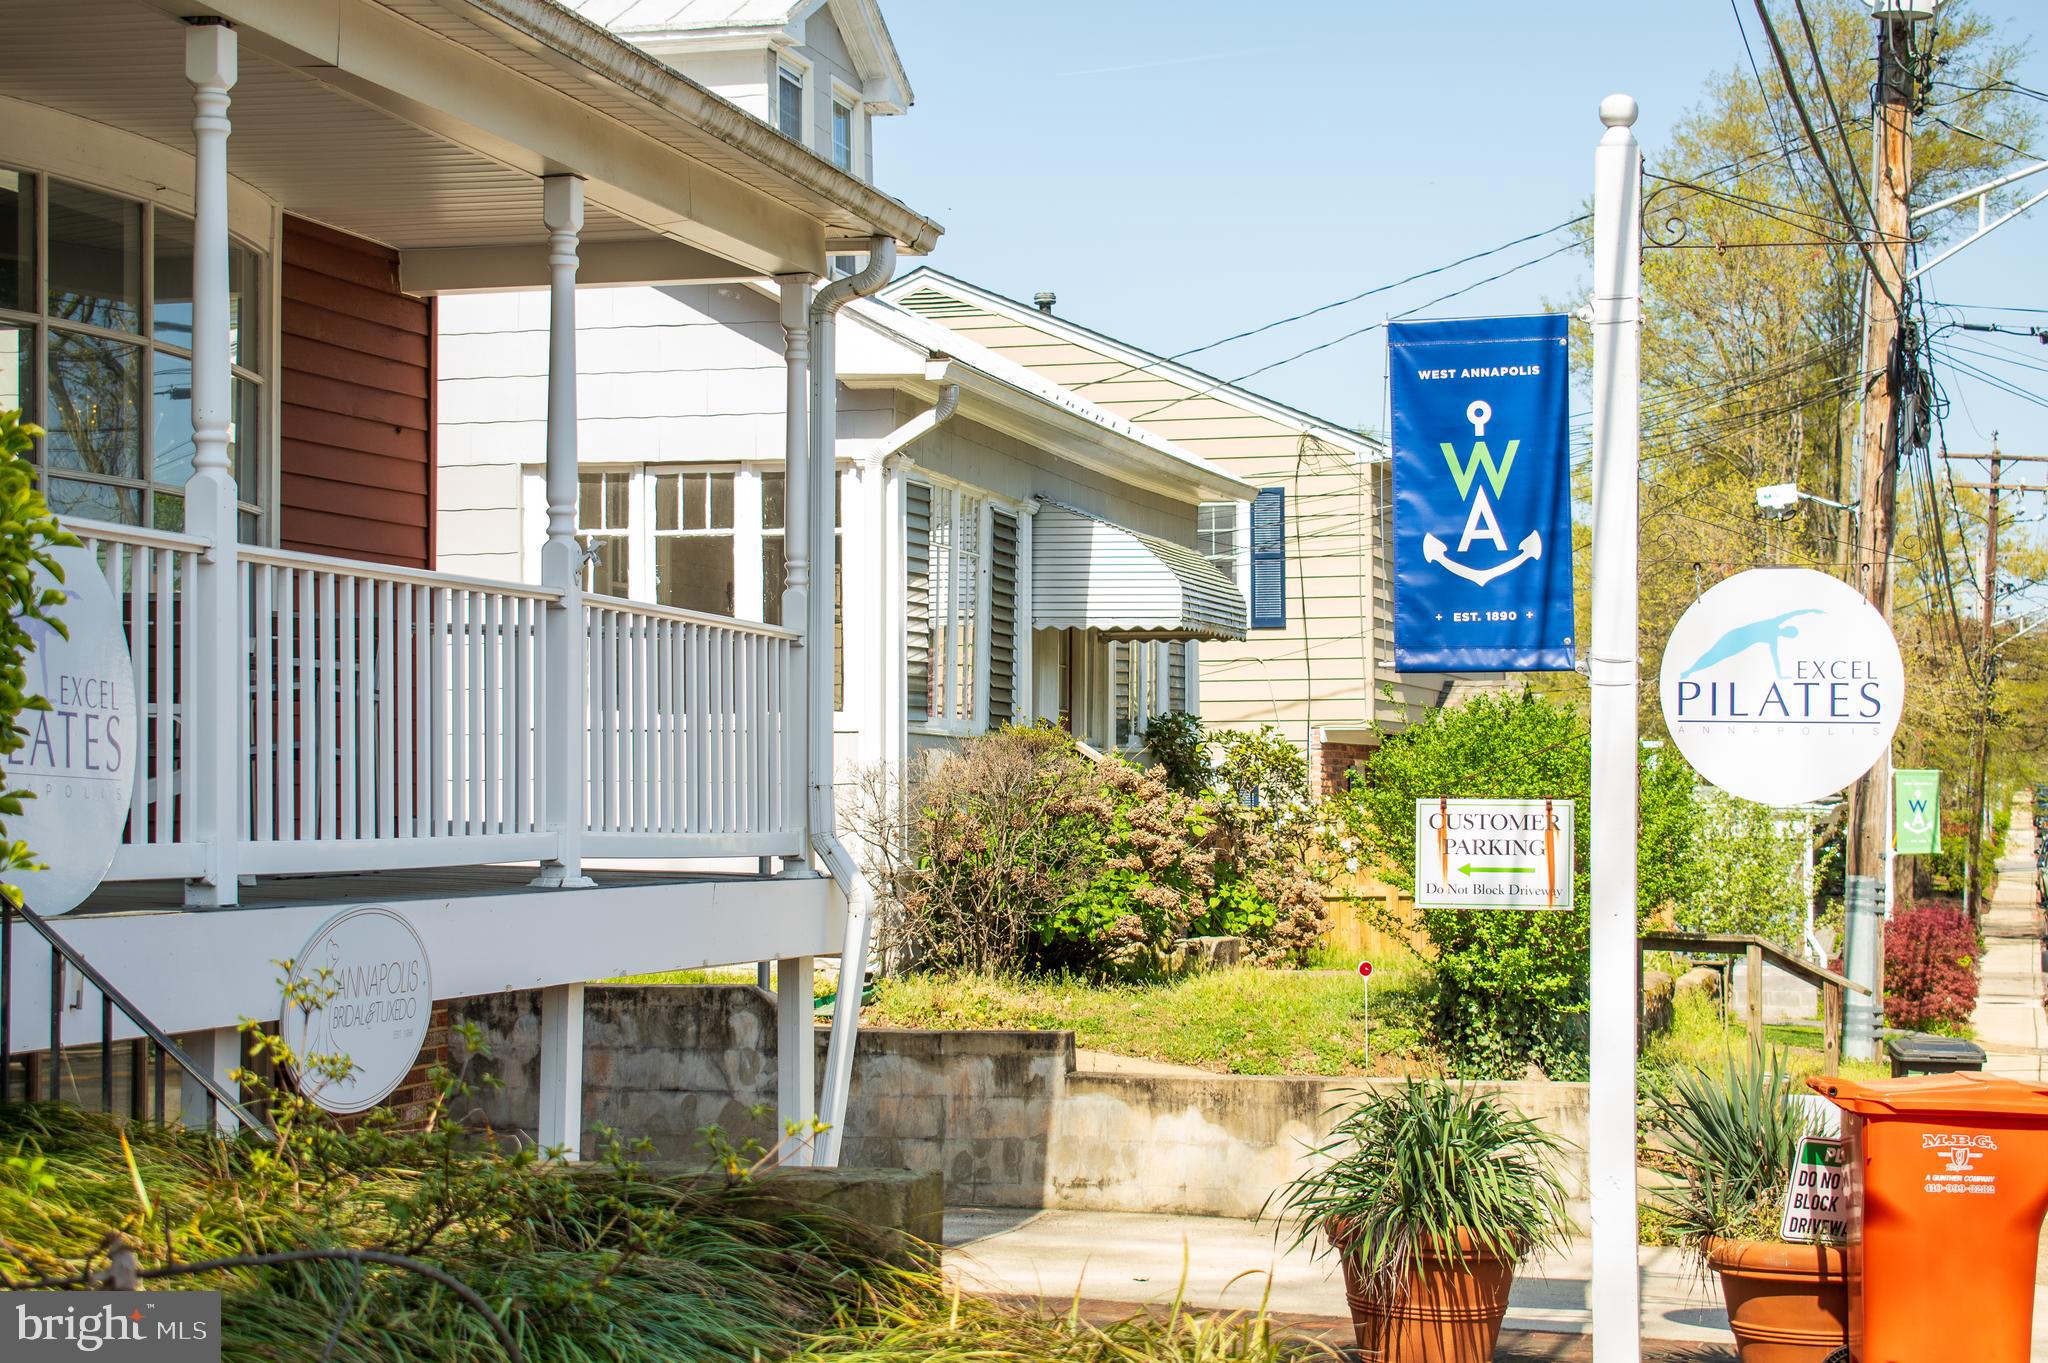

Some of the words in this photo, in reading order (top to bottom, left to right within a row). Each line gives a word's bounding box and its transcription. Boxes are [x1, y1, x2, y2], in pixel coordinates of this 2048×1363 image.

[1418, 369, 1457, 380] WEST
[1461, 365, 1540, 379] ANNAPOLIS
[1453, 611, 1482, 622] EST.
[1486, 610, 1517, 621] 1890
[1797, 660, 1878, 680] EXCEL
[60, 675, 119, 710] EXCEL
[1677, 681, 1881, 718] PILATES
[1677, 726, 1880, 736] ANNAPOLIS
[1429, 812, 1561, 832] CUSTOMER
[1444, 838, 1546, 856] PARKING
[1426, 883, 1444, 895] Do
[1447, 884, 1468, 895] Not
[1473, 883, 1505, 895] Block
[1509, 884, 1564, 899] Driveway
[336, 960, 419, 1000] ANNAPOLIS
[1922, 1134, 1998, 1150] M.B.G.
[1798, 1170, 1817, 1187] DO
[1793, 1193, 1839, 1212] BLOCK
